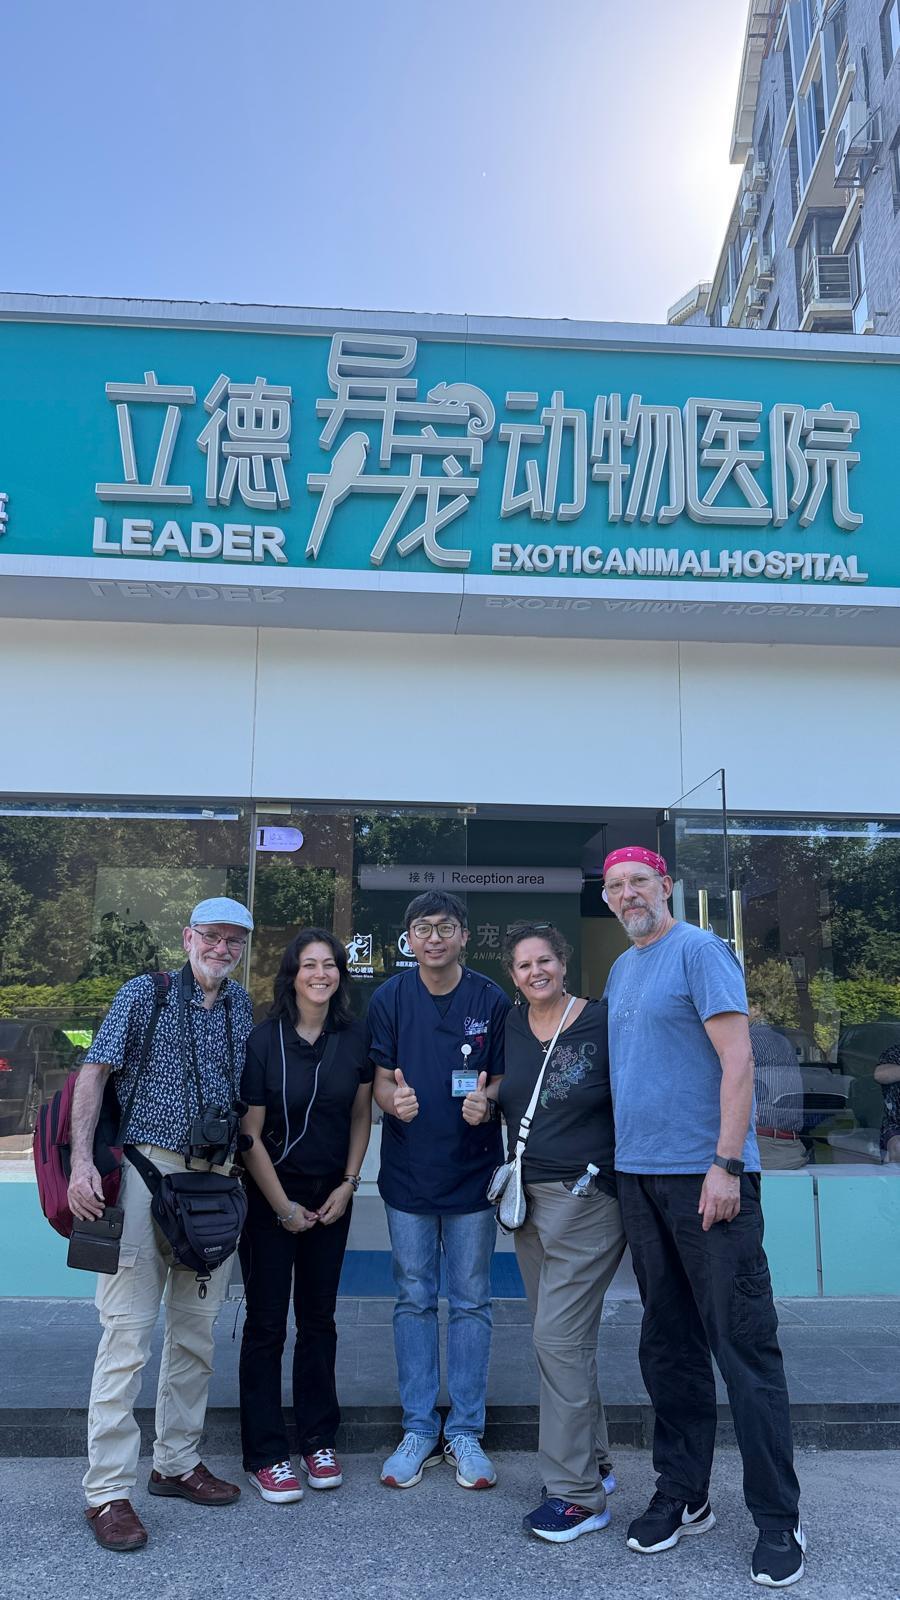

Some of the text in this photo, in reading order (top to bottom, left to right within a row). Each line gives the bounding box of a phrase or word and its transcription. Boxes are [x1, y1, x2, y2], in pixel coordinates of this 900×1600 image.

[92, 517, 288, 562] LEADER
[408, 871, 436, 883] 接待
[451, 872, 545, 886] Reception area
[473, 951, 505, 960] ANIMA
